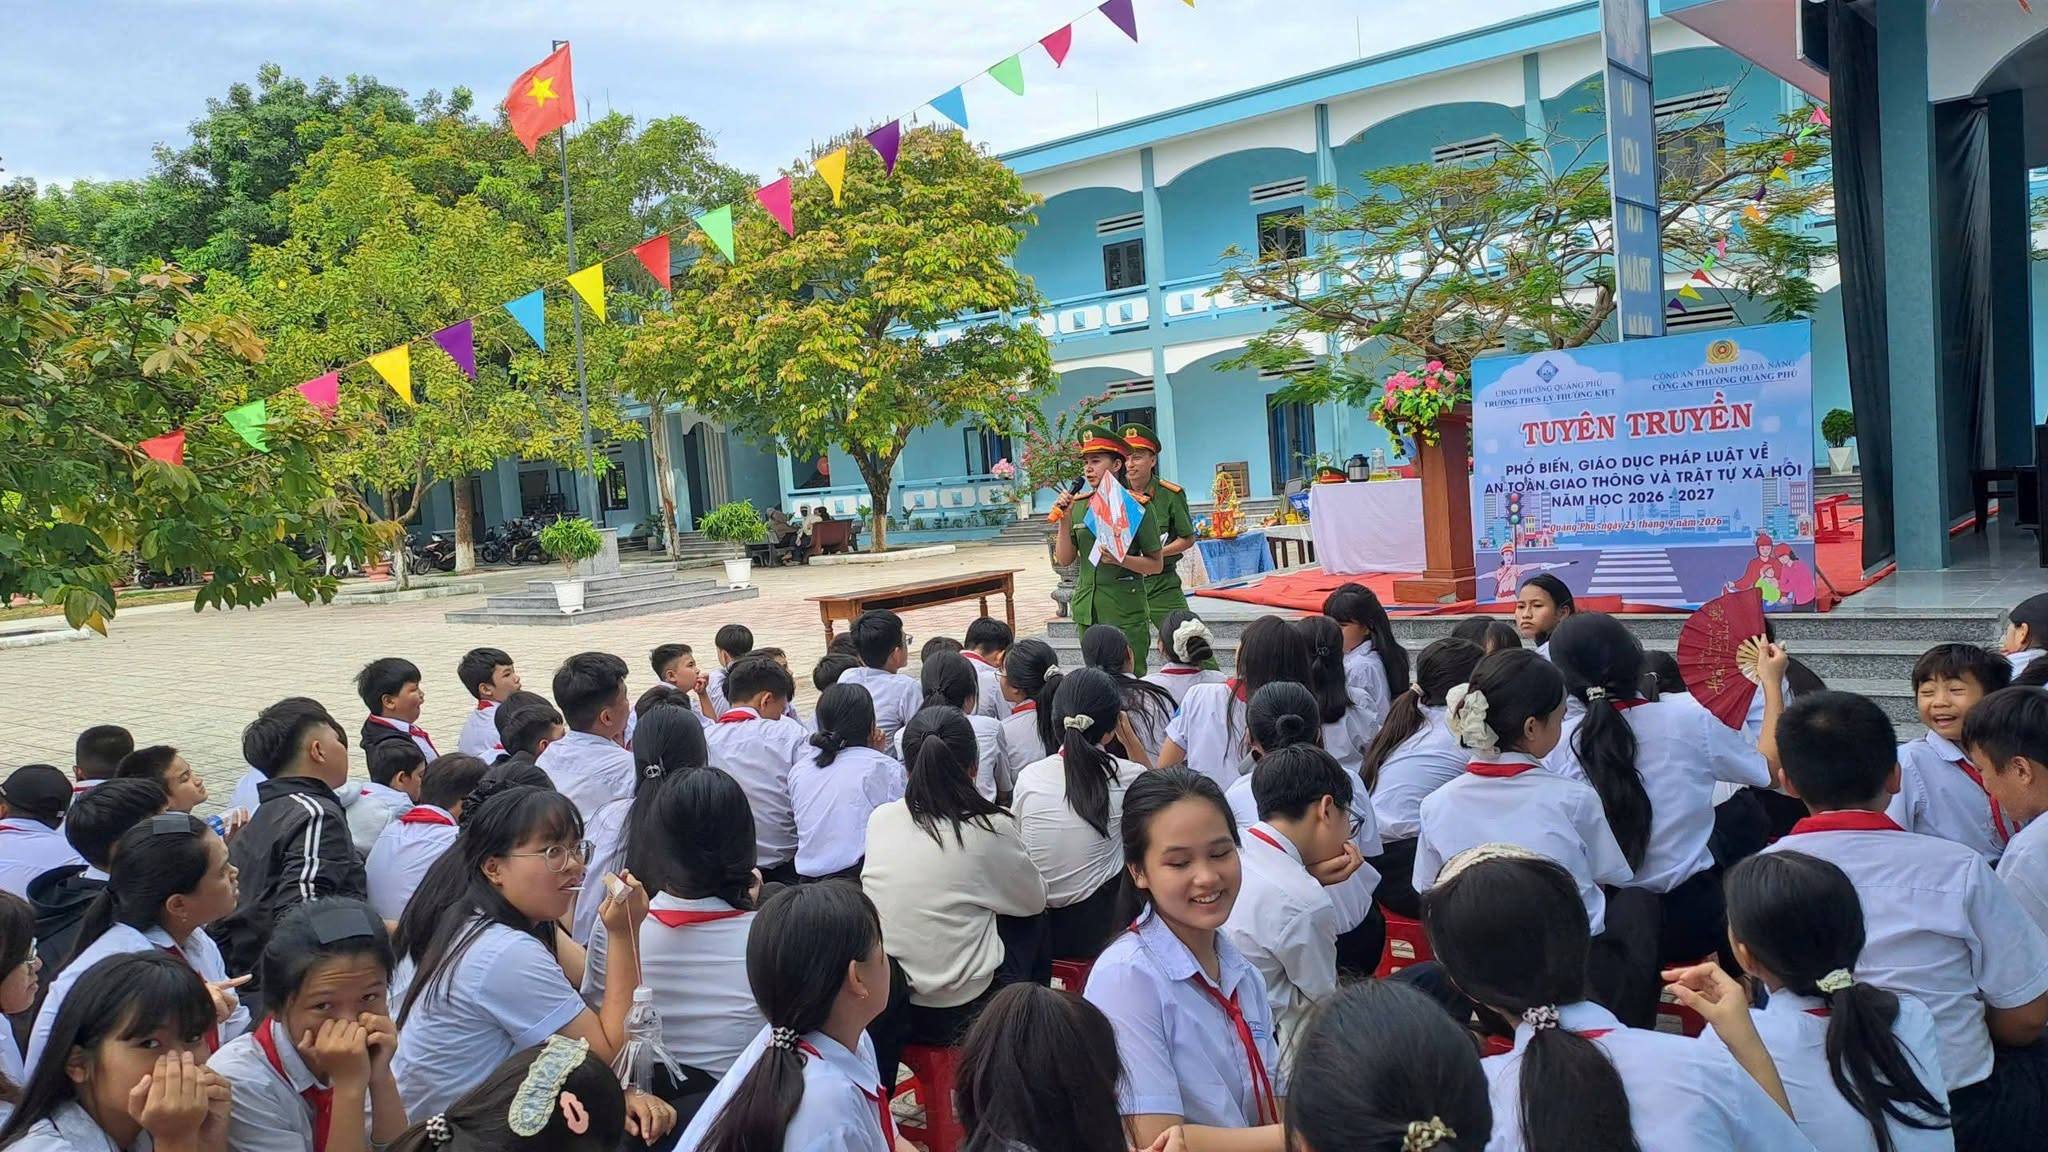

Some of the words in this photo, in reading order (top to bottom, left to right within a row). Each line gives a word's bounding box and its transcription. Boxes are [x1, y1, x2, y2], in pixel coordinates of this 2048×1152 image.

[1682, 367, 1694, 377] AN
[1680, 379, 1694, 389] AN
[1519, 396, 1541, 406] THCS
[1522, 411, 1616, 446] TUYÊN
[1626, 391, 1752, 437] TRUYỀN
[1505, 457, 1535, 476] PHỔ
[1539, 456, 1574, 474] BIẾN,
[1578, 455, 1617, 472] GIÁO
[1622, 454, 1655, 471] DỤC
[1659, 449, 1701, 467] PHÁP
[1706, 446, 1744, 465] LUẬT
[1749, 441, 1769, 460] VỀ
[1485, 482, 1504, 494] AN
[1508, 474, 1545, 493] TOÀN
[1550, 477, 1587, 490] GIAO
[1592, 472, 1645, 488] THÔNG
[1650, 468, 1671, 485] VÀ
[1676, 467, 1713, 486] TRẬT
[1717, 465, 1737, 484] TỰ
[1742, 463, 1765, 480] XÃ
[1771, 461, 1802, 480] HỘI
[1551, 493, 1584, 508] NĂM
[1589, 493, 1623, 509] HỌC
[1628, 491, 1664, 503] 2026
[1678, 488, 1715, 501] 2027
[1625, 520, 1636, 529] 25
